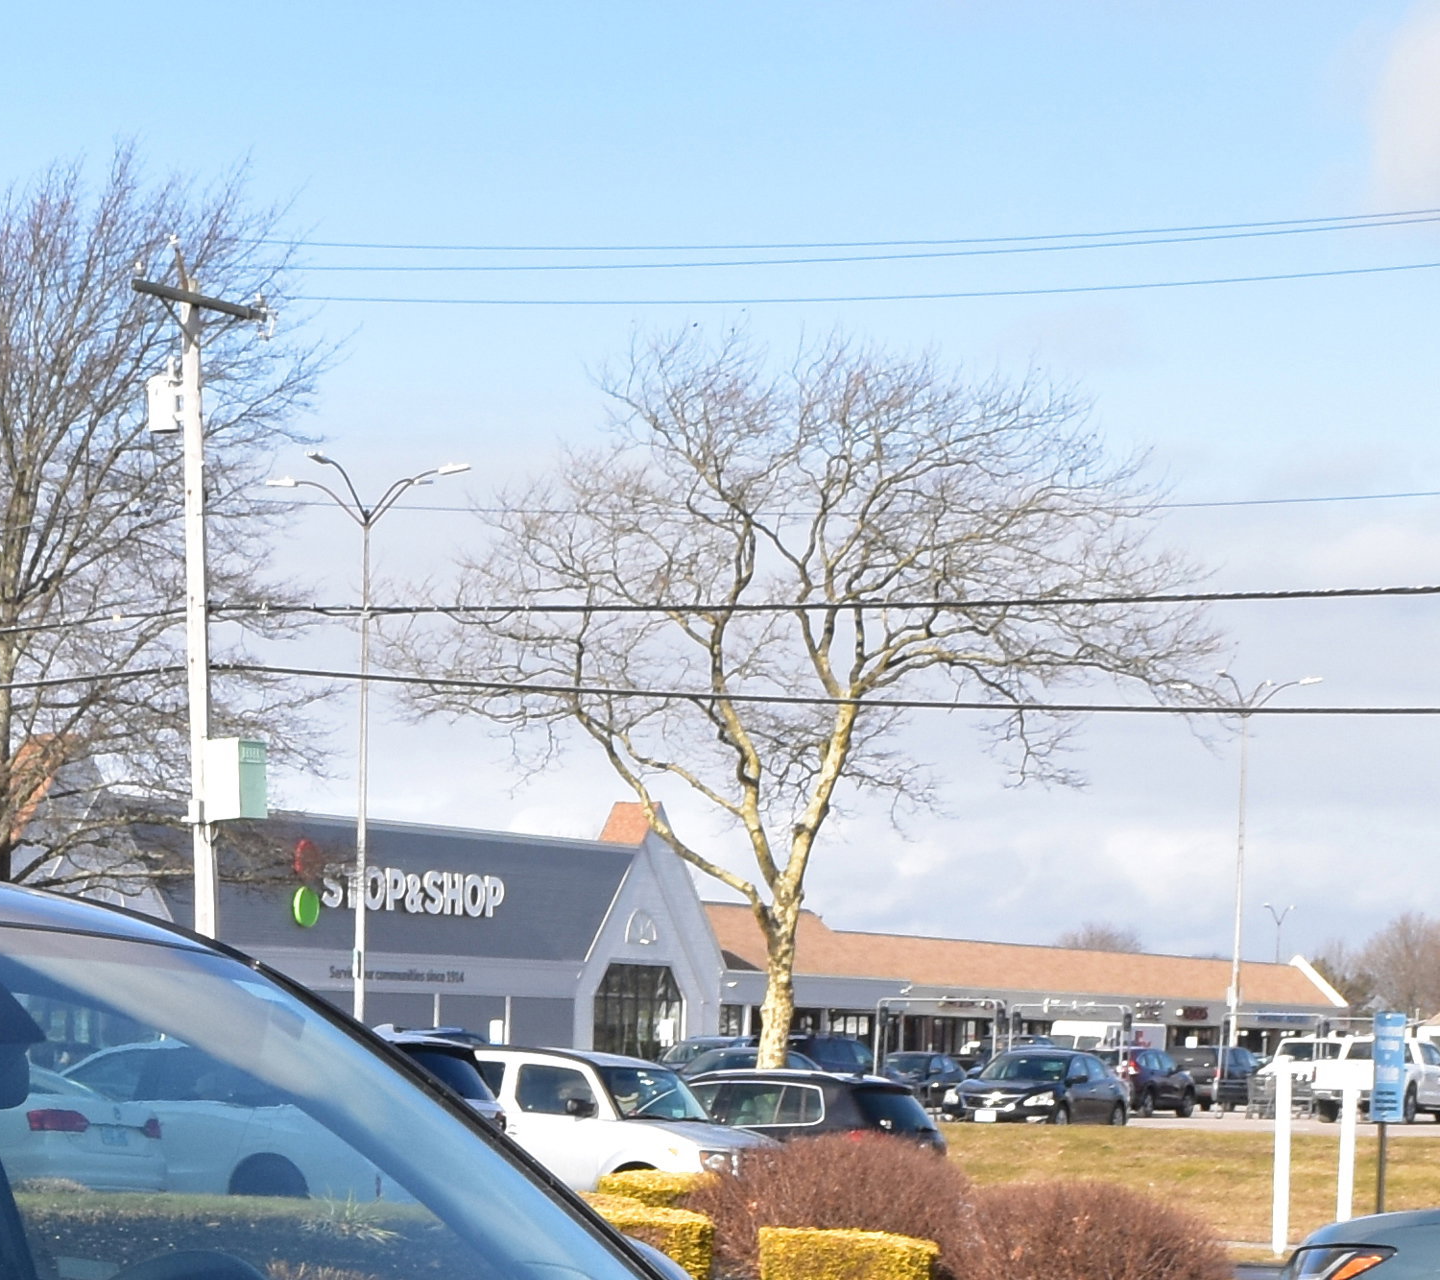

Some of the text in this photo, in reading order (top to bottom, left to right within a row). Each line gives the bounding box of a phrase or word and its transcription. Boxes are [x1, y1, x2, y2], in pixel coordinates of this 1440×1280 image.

[375, 968, 425, 982] communities
[426, 969, 445, 982] since
[446, 970, 465, 983] 1914
